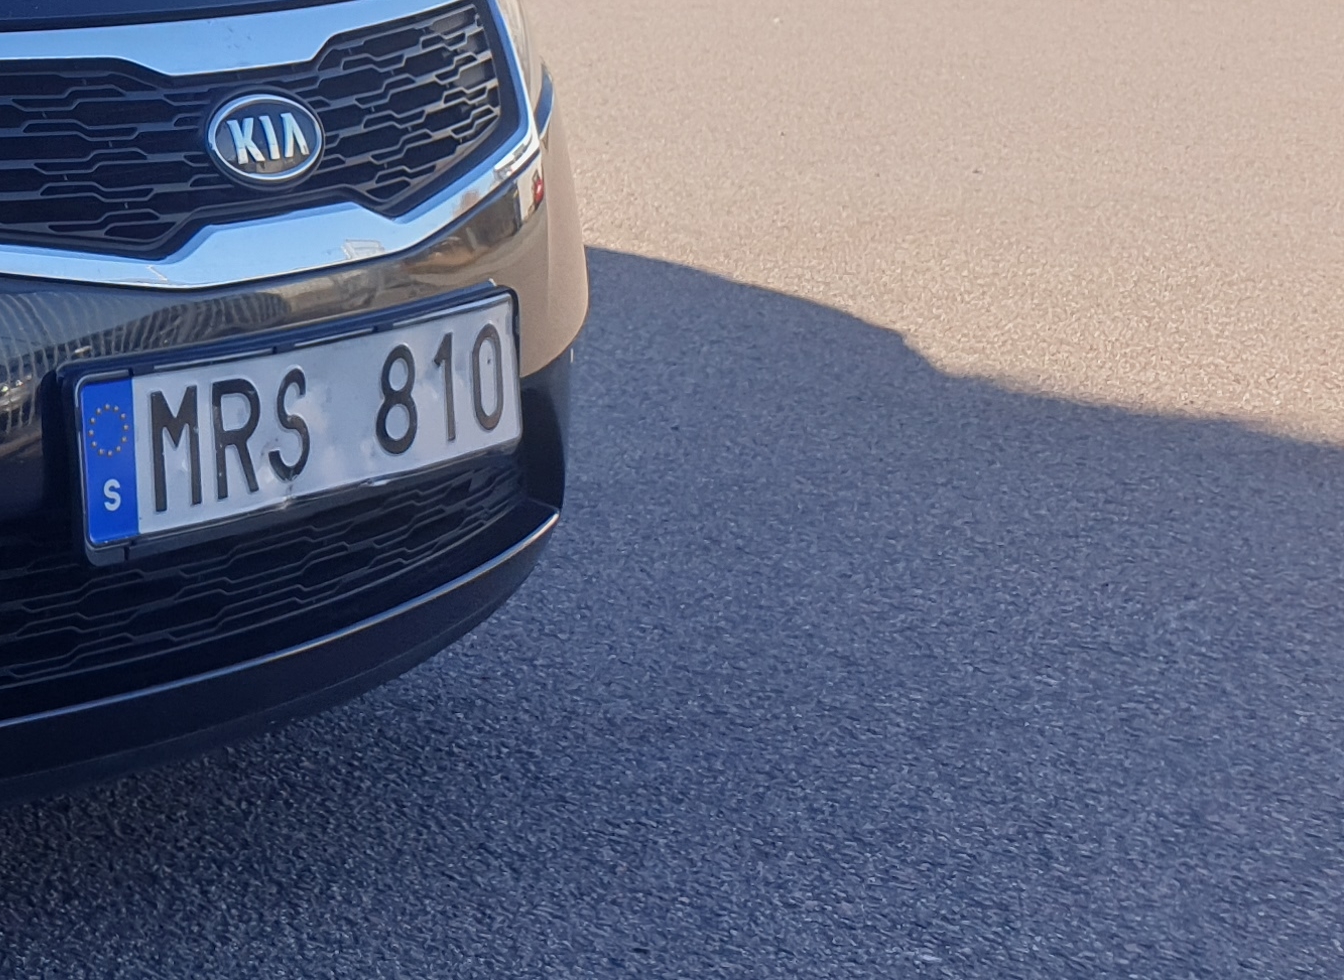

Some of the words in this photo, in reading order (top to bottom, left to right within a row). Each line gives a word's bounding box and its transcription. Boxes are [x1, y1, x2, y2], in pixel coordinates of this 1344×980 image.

[226, 112, 310, 165] KIA
[150, 365, 311, 512] MRS
[375, 323, 504, 455] 810
[103, 479, 122, 511] S
